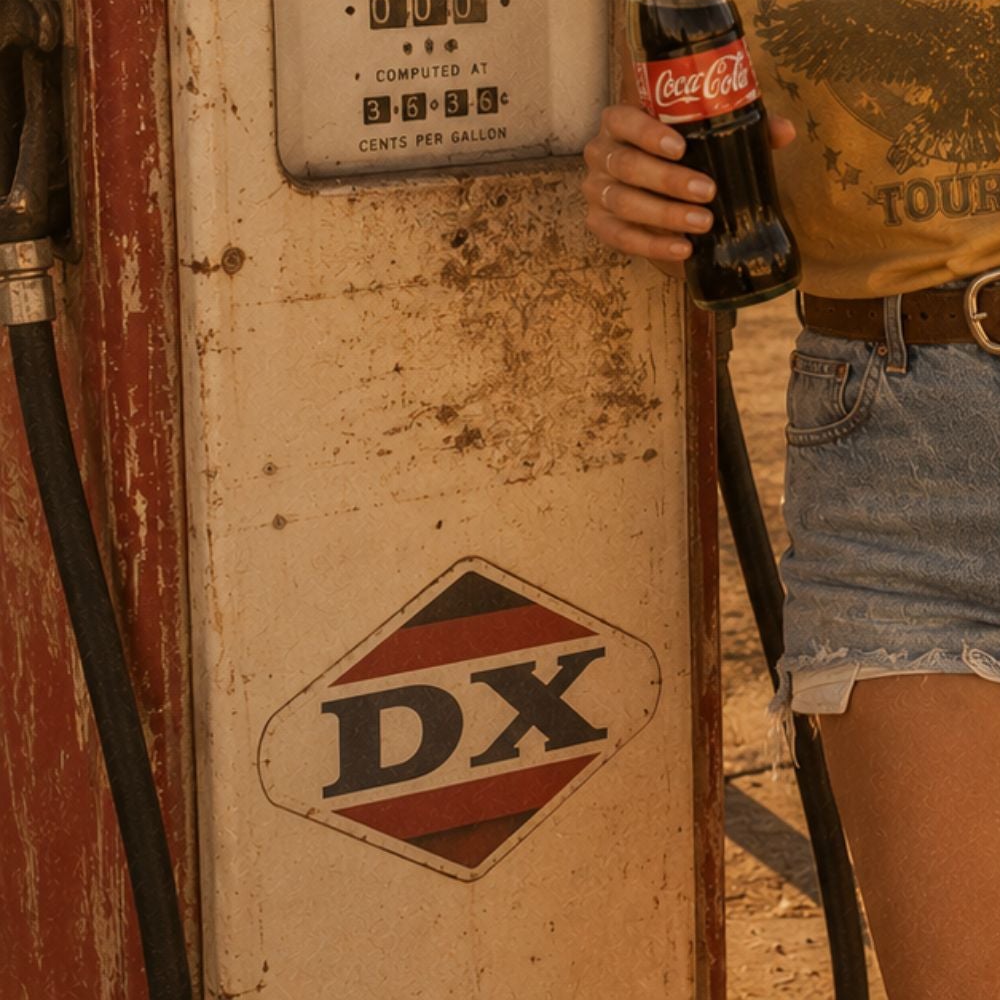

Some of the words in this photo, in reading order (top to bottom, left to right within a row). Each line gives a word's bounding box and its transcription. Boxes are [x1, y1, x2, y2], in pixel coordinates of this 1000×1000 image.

[375, 63, 461, 82] COMPUTED
[470, 62, 488, 75] AT
[358, 135, 408, 153] CENTS
[415, 132, 443, 147] PER
[450, 126, 508, 144] GALLON
[320, 645, 608, 800] DX
